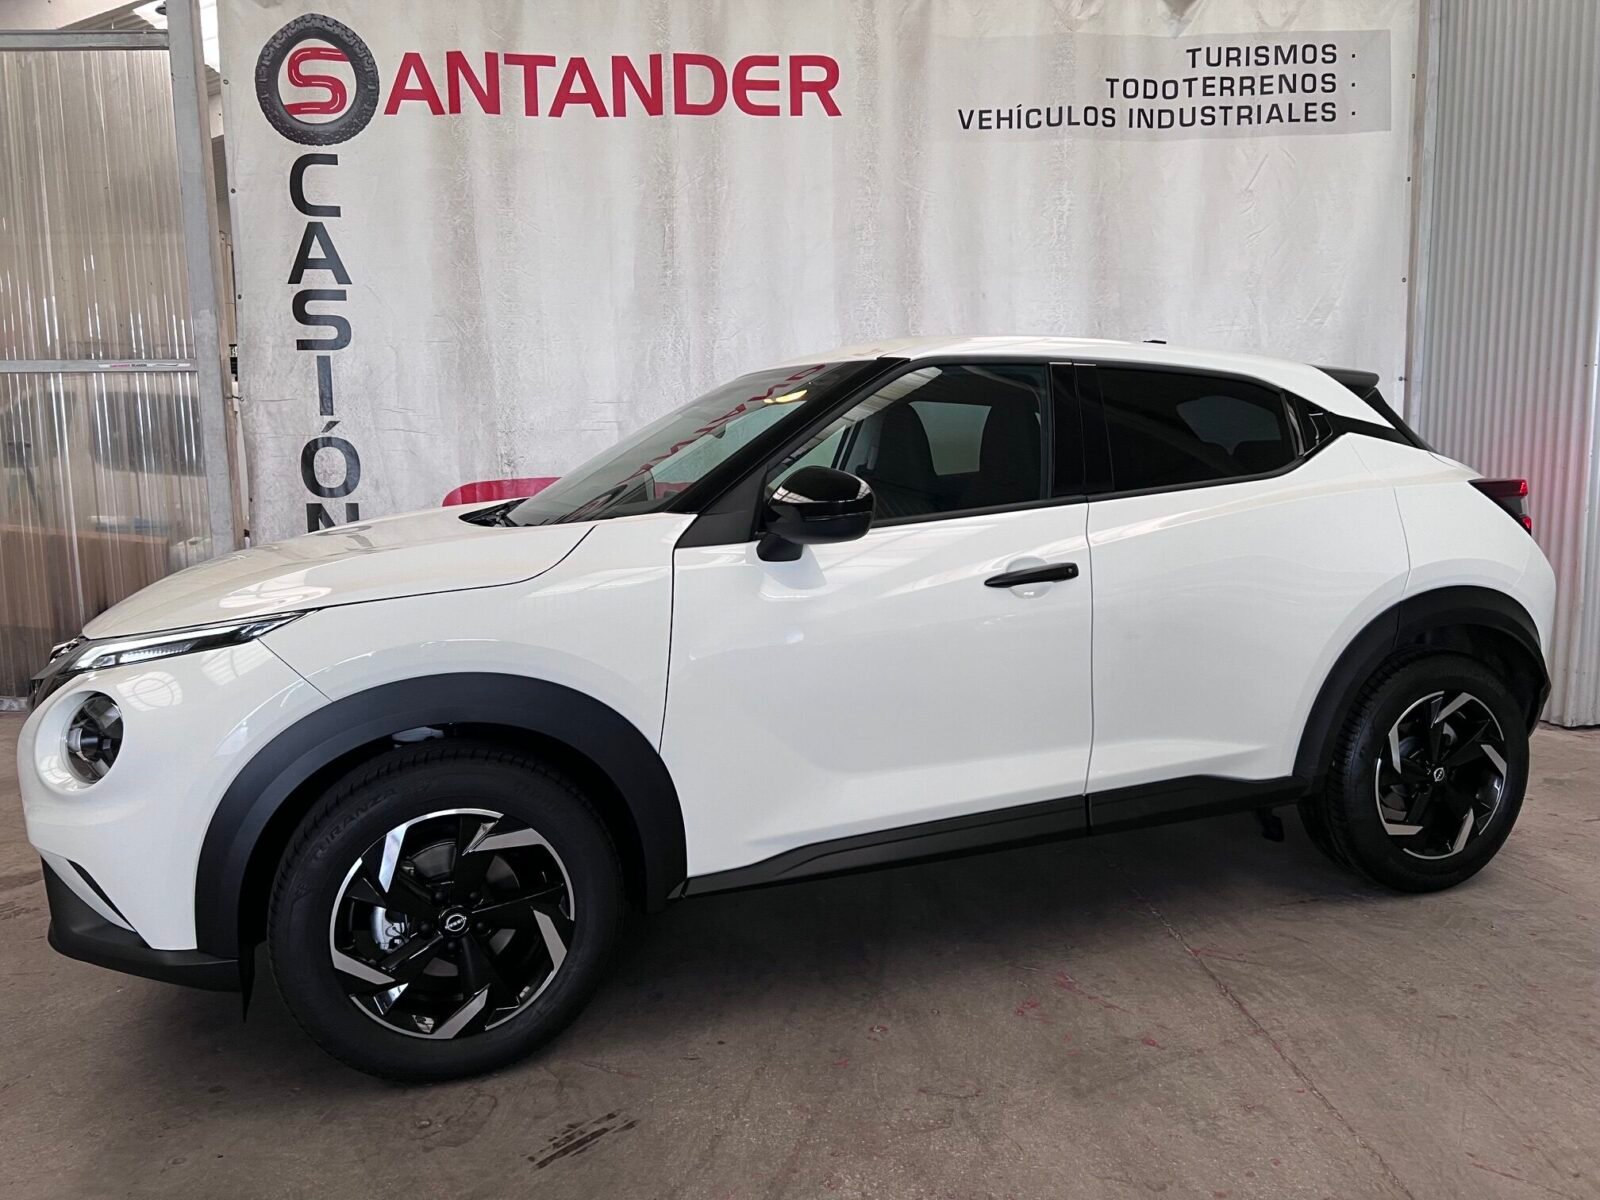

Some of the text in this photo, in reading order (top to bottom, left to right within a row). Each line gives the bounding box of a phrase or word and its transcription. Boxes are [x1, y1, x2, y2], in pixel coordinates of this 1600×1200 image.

[1185, 43, 1338, 69] TURISMOS
[1105, 73, 1338, 100] TODOTERRENOS
[957, 102, 1338, 130] VEHÍCULOS INDUSTRIALES
